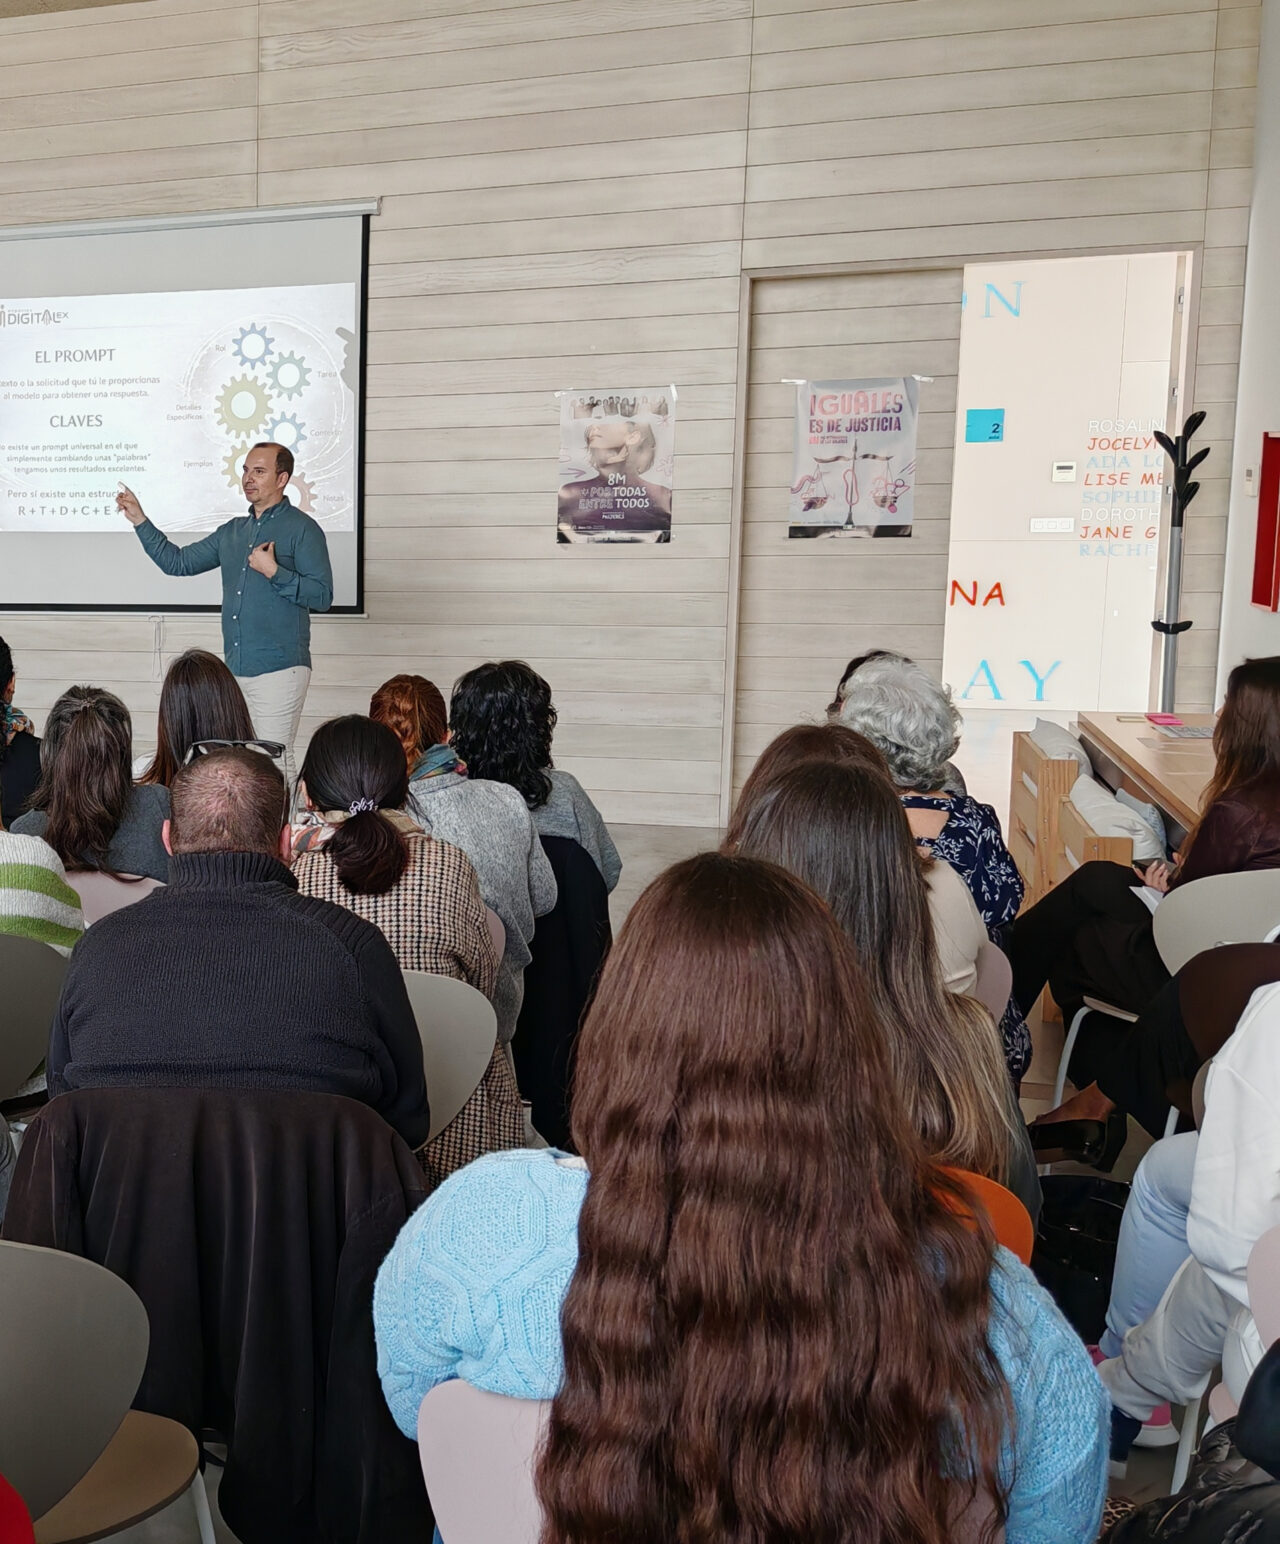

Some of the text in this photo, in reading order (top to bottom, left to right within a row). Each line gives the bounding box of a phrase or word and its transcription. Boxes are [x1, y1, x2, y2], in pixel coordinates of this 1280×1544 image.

[35, 348, 116, 364] EL PROMPT
[27, 379, 34, 387] la
[36, 378, 70, 387] solicitud
[72, 380, 86, 389] que
[99, 377, 107, 385] le
[108, 376, 160, 388] proporcionas
[4, 392, 11, 400] al
[12, 391, 40, 400] modelo
[42, 392, 59, 401] para
[61, 390, 92, 399] obtener
[110, 390, 149, 400] respuesta.
[810, 391, 903, 416] IGUALES
[50, 414, 103, 428] CLAVES
[809, 416, 901, 433] ES DE JUSTICIA
[992, 423, 1000, 434] 2
[42, 444, 69, 452] prompt
[124, 443, 138, 451] que
[6, 454, 53, 463] simplemente
[54, 454, 93, 462] cambiando
[1086, 455, 1130, 469] ADA
[14, 466, 48, 474] tengamos
[69, 465, 106, 473] resultados
[608, 473, 626, 486] 8M
[1084, 472, 1130, 486] LISE
[7, 490, 27, 498] Pero
[39, 489, 66, 498] existe
[579, 498, 650, 509] ENTRE TODOS
[1080, 526, 1133, 539] JANE
[950, 580, 1005, 606] NA
